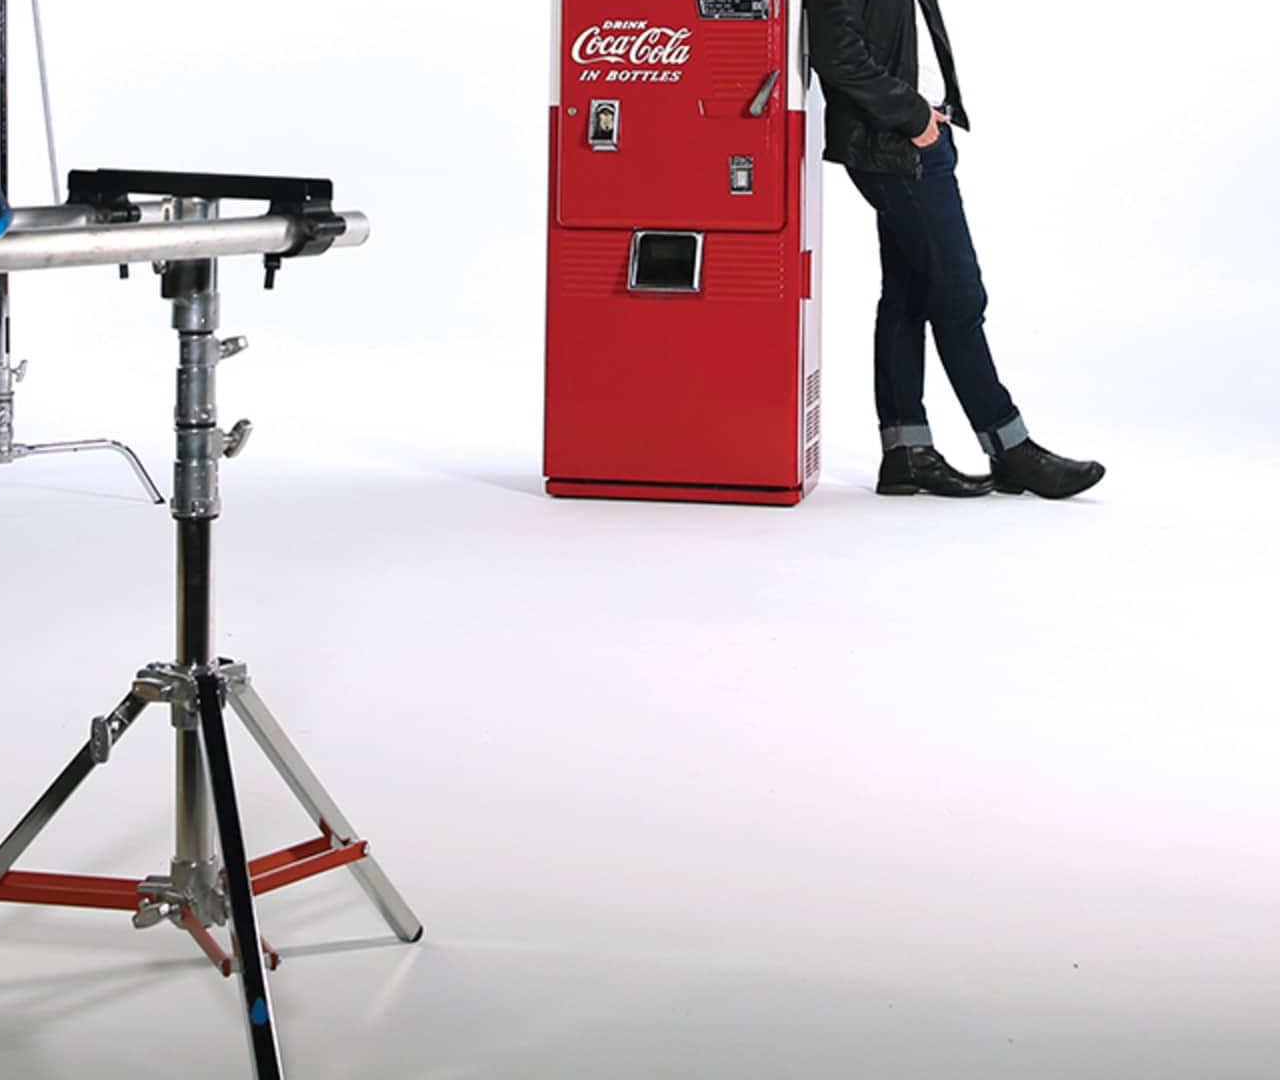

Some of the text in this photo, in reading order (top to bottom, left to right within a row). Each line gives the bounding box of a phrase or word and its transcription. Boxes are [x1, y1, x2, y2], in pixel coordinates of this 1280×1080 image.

[602, 20, 649, 30] DRINK
[579, 69, 683, 82] IN BOTTLES
